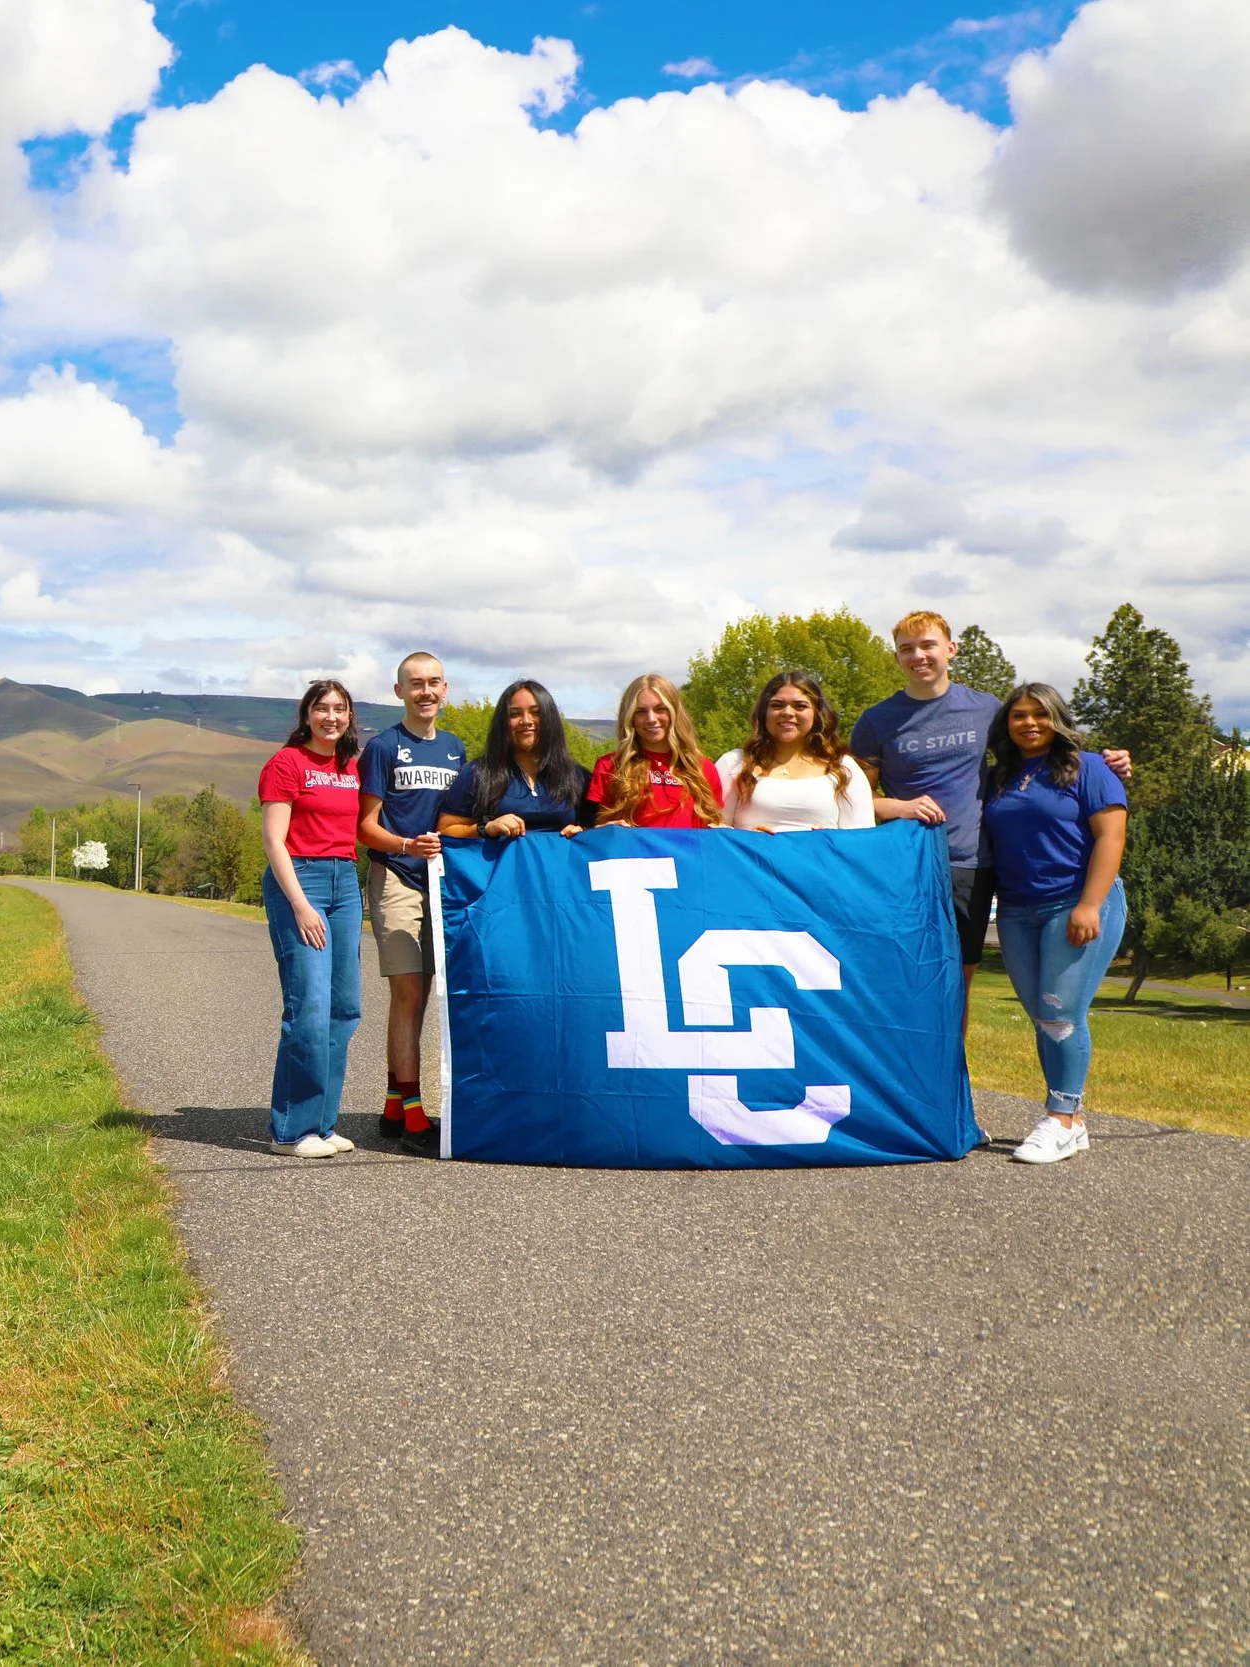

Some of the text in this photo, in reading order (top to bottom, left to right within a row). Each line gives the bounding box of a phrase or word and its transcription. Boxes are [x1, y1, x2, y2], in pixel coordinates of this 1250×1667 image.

[898, 730, 977, 754] LC STATE
[588, 856, 851, 1146] LC
